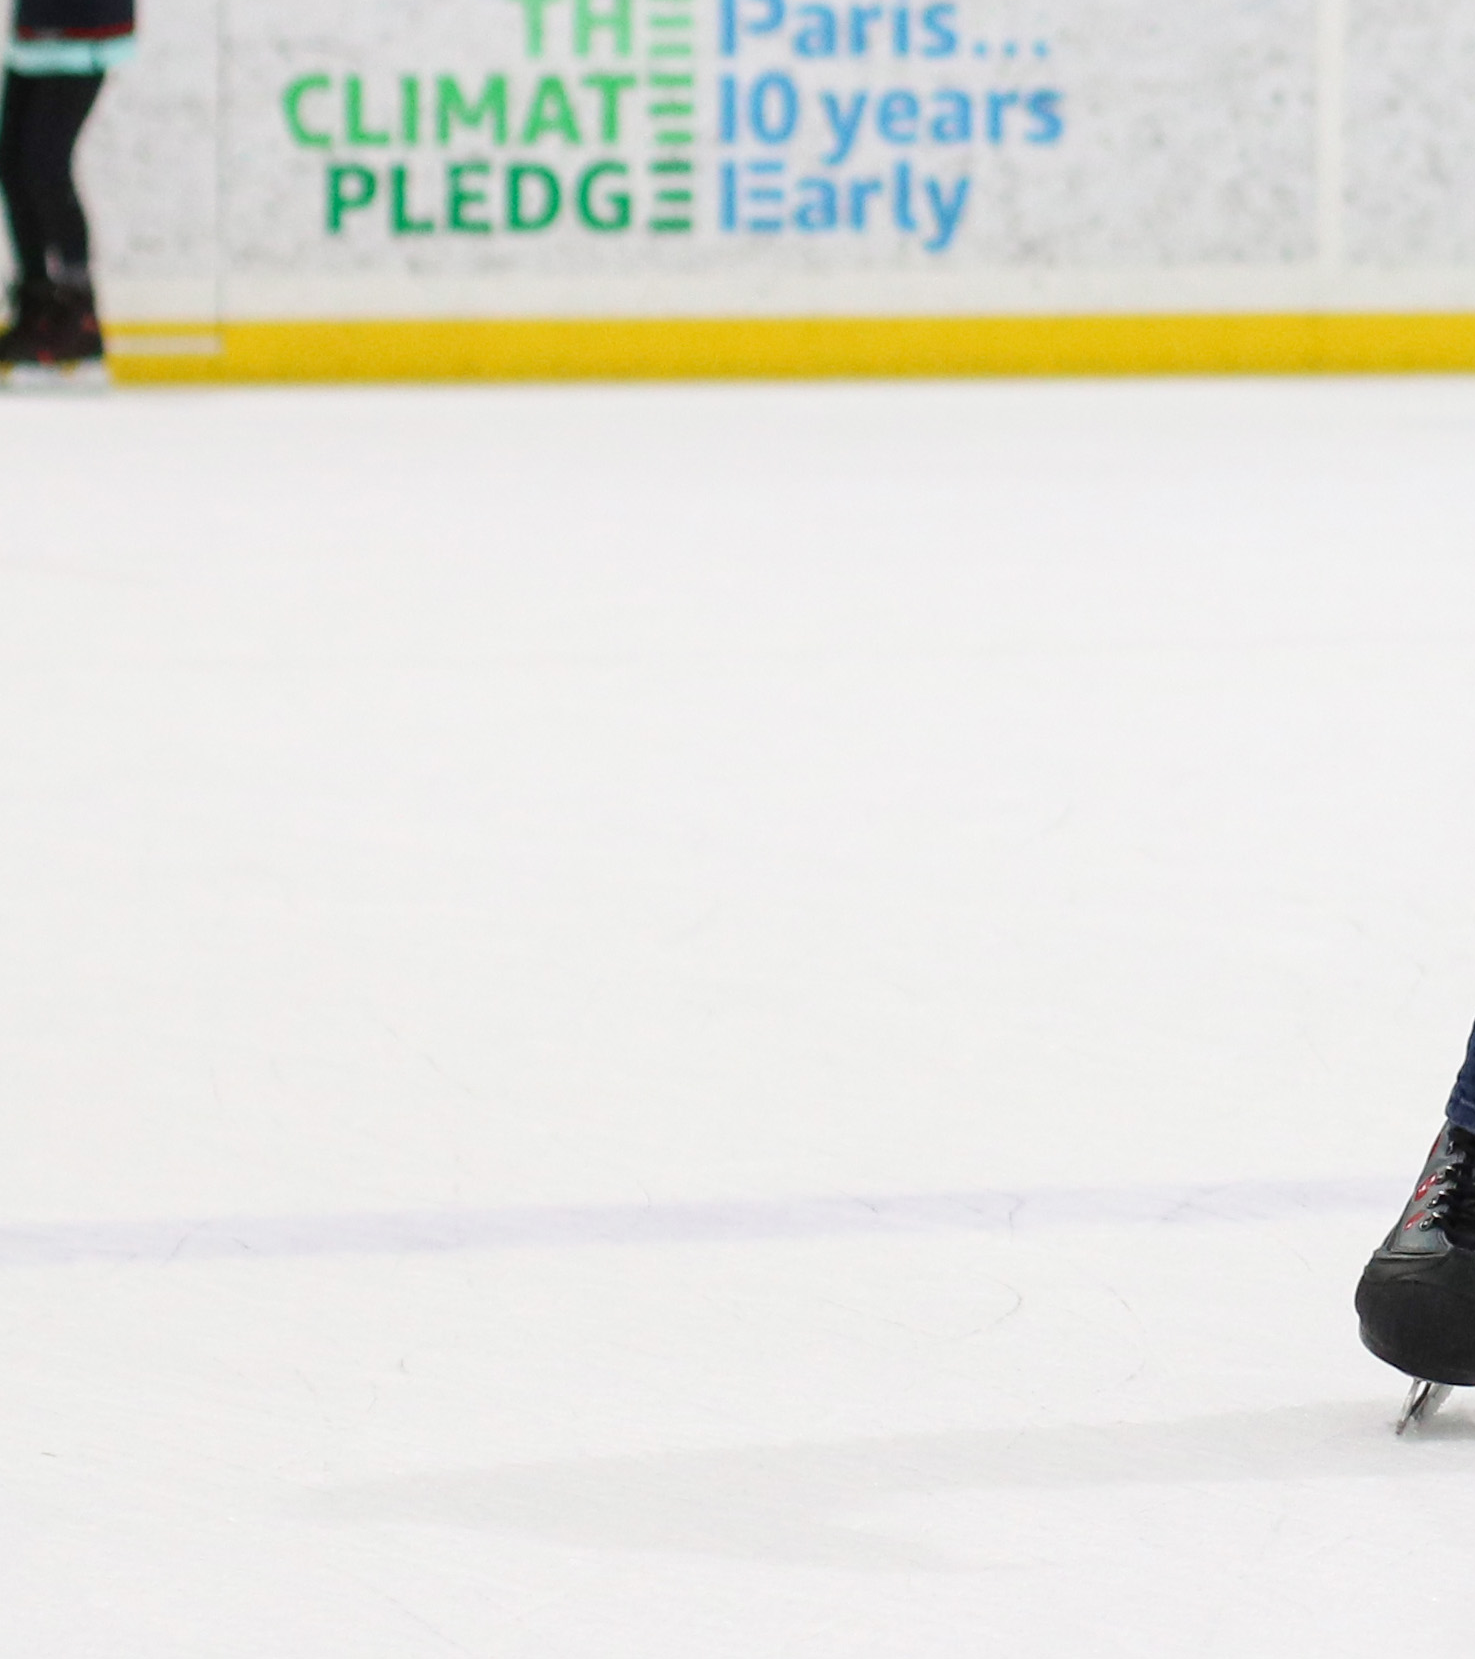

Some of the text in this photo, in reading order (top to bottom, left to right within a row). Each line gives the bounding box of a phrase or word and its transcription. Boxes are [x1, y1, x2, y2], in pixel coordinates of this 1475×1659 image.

[282, 73, 694, 149] CLIMATE
[820, 87, 1066, 167] years
[325, 160, 694, 236] PLEDGE
[719, 158, 972, 253] Early
